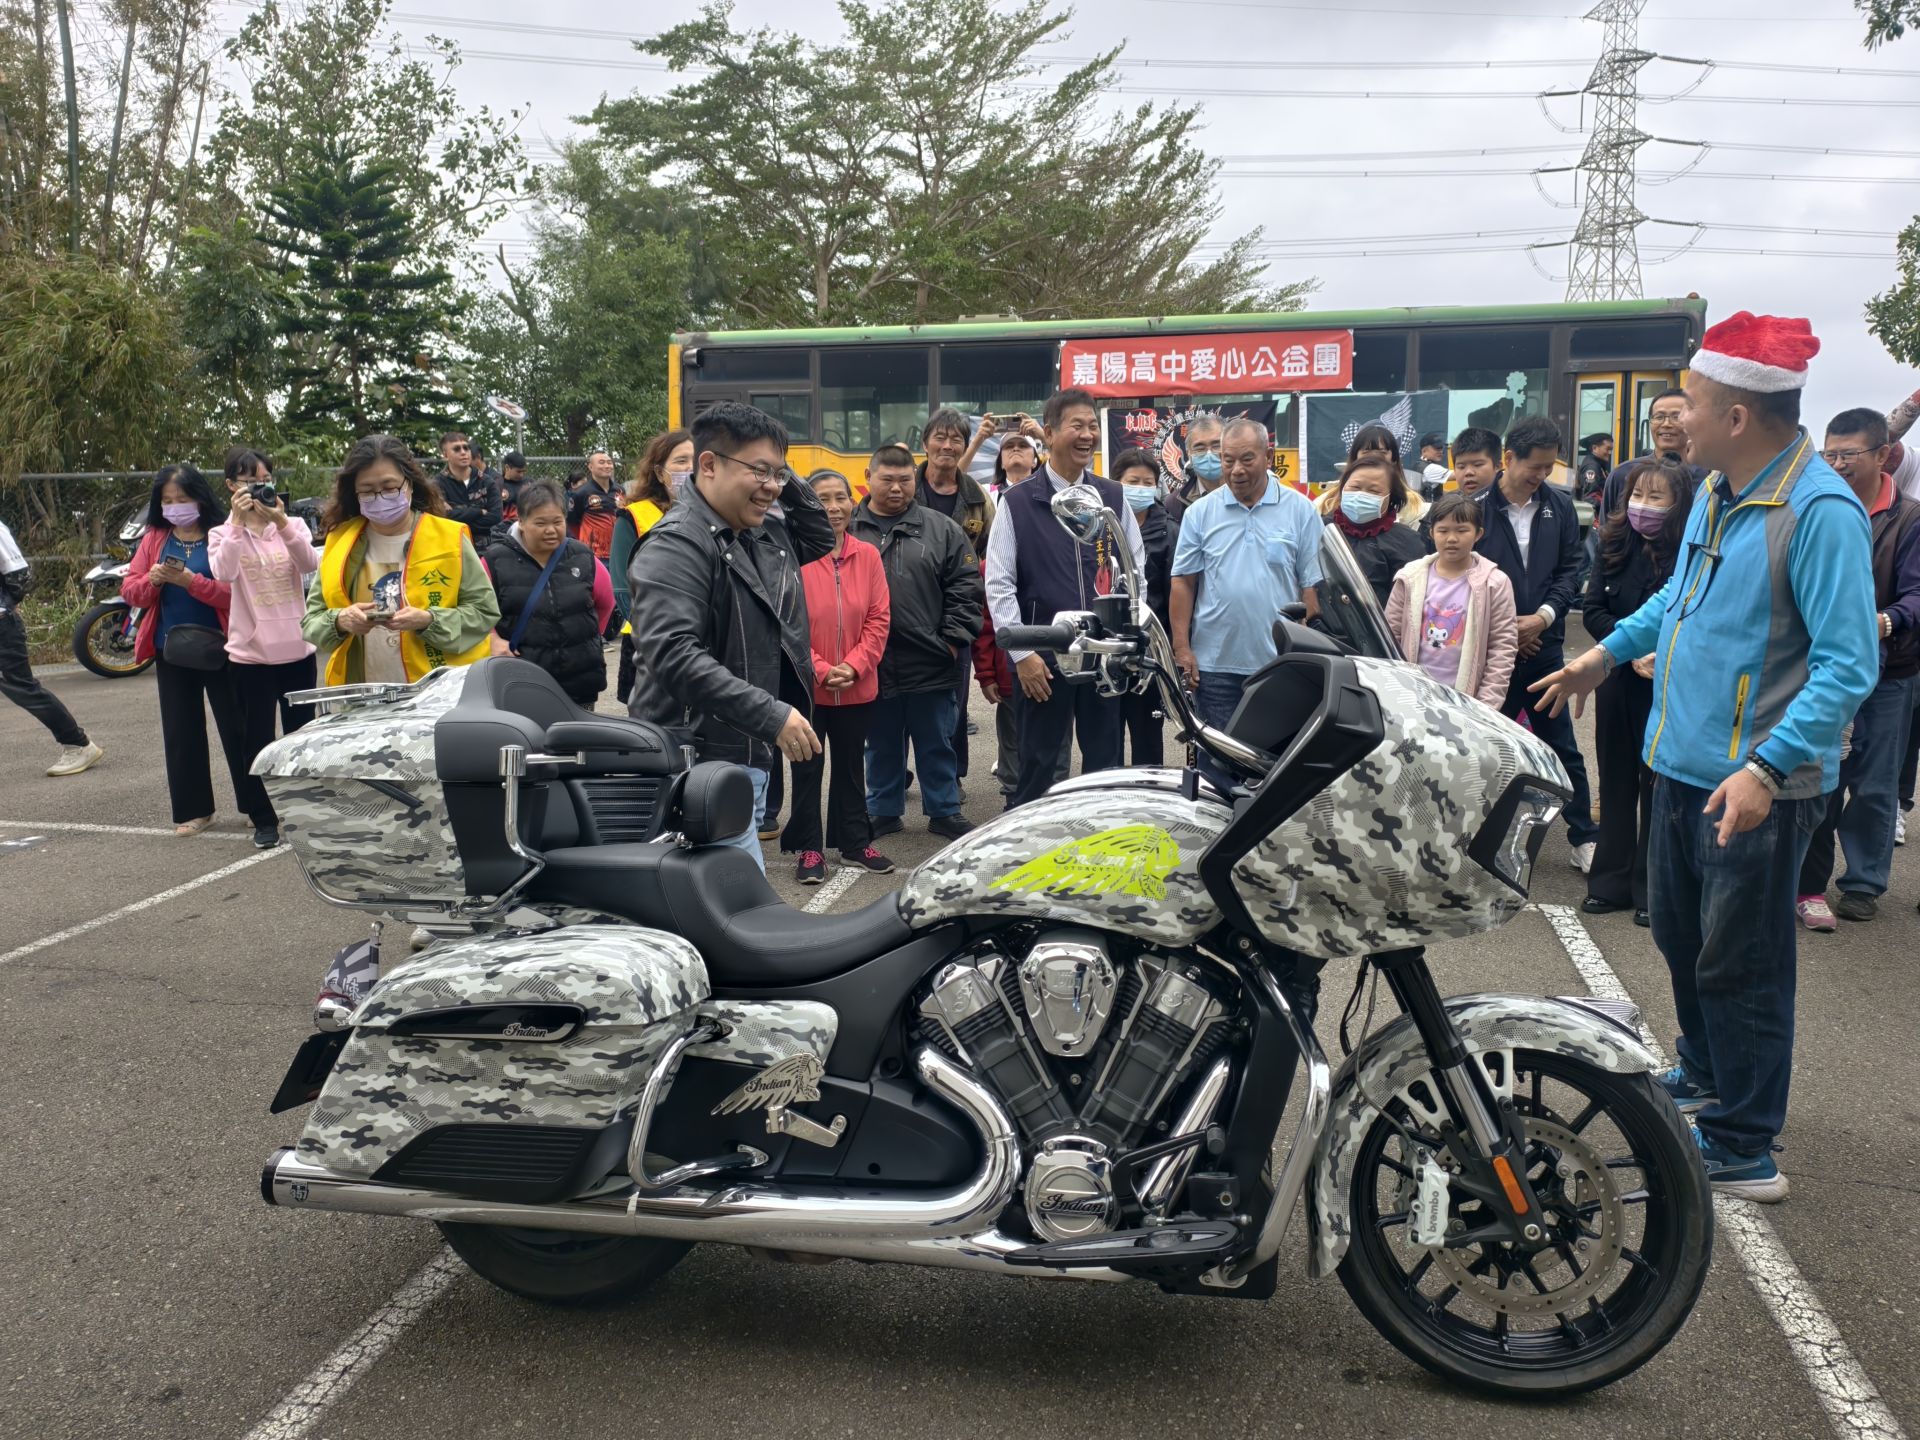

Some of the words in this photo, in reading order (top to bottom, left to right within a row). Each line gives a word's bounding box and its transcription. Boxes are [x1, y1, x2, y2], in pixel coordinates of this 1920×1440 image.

[1072, 342, 1341, 386] 嘉陽高中愛心公益團
[503, 1022, 547, 1038] Indian
[745, 1078, 792, 1094] Indian
[1040, 1193, 1105, 1214] Indian
[1427, 1190, 1440, 1233] brembo
